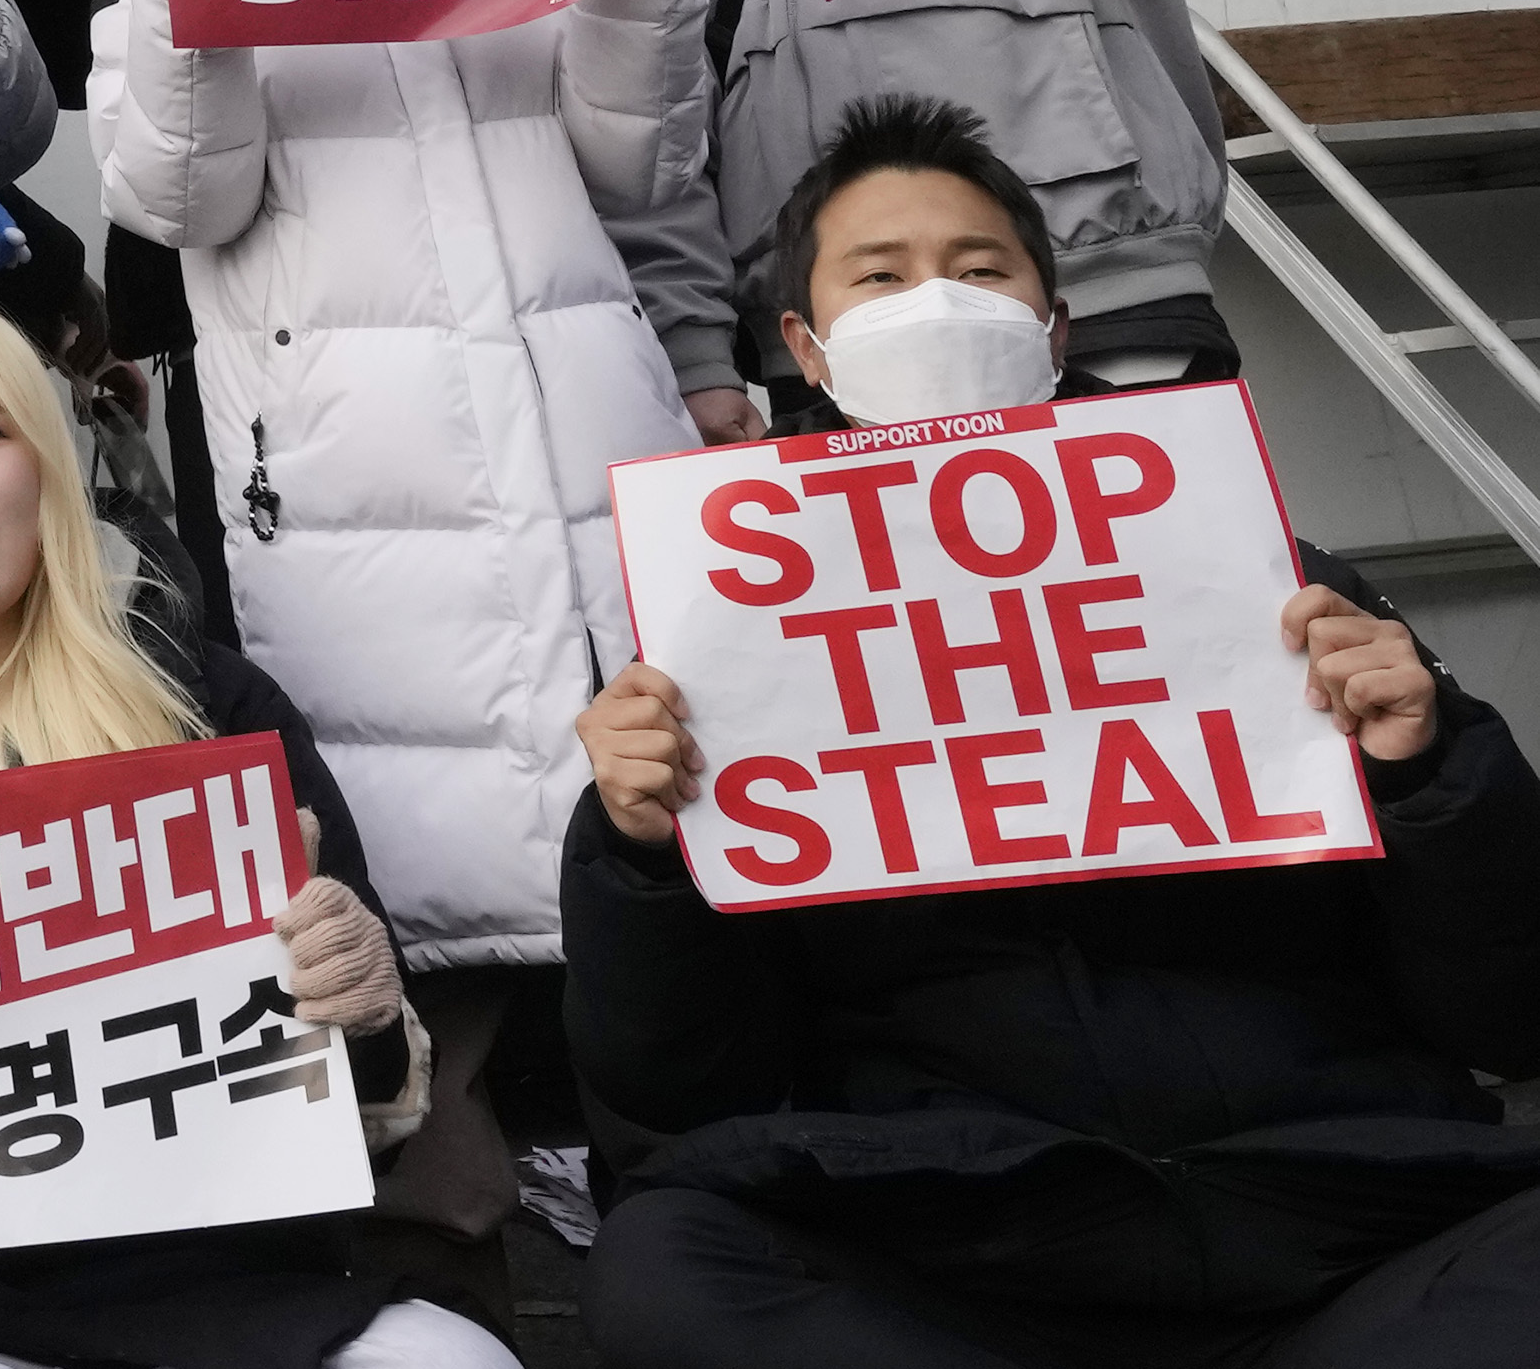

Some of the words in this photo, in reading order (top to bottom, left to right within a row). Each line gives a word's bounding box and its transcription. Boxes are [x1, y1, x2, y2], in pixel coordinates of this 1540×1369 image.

[825, 421, 935, 457] SUPPORT
[938, 412, 1006, 443] YOON
[700, 431, 1176, 607] STOP
[779, 573, 1171, 735] THE
[713, 708, 1327, 888] STEAL
[100, 974, 333, 1142] 구속
